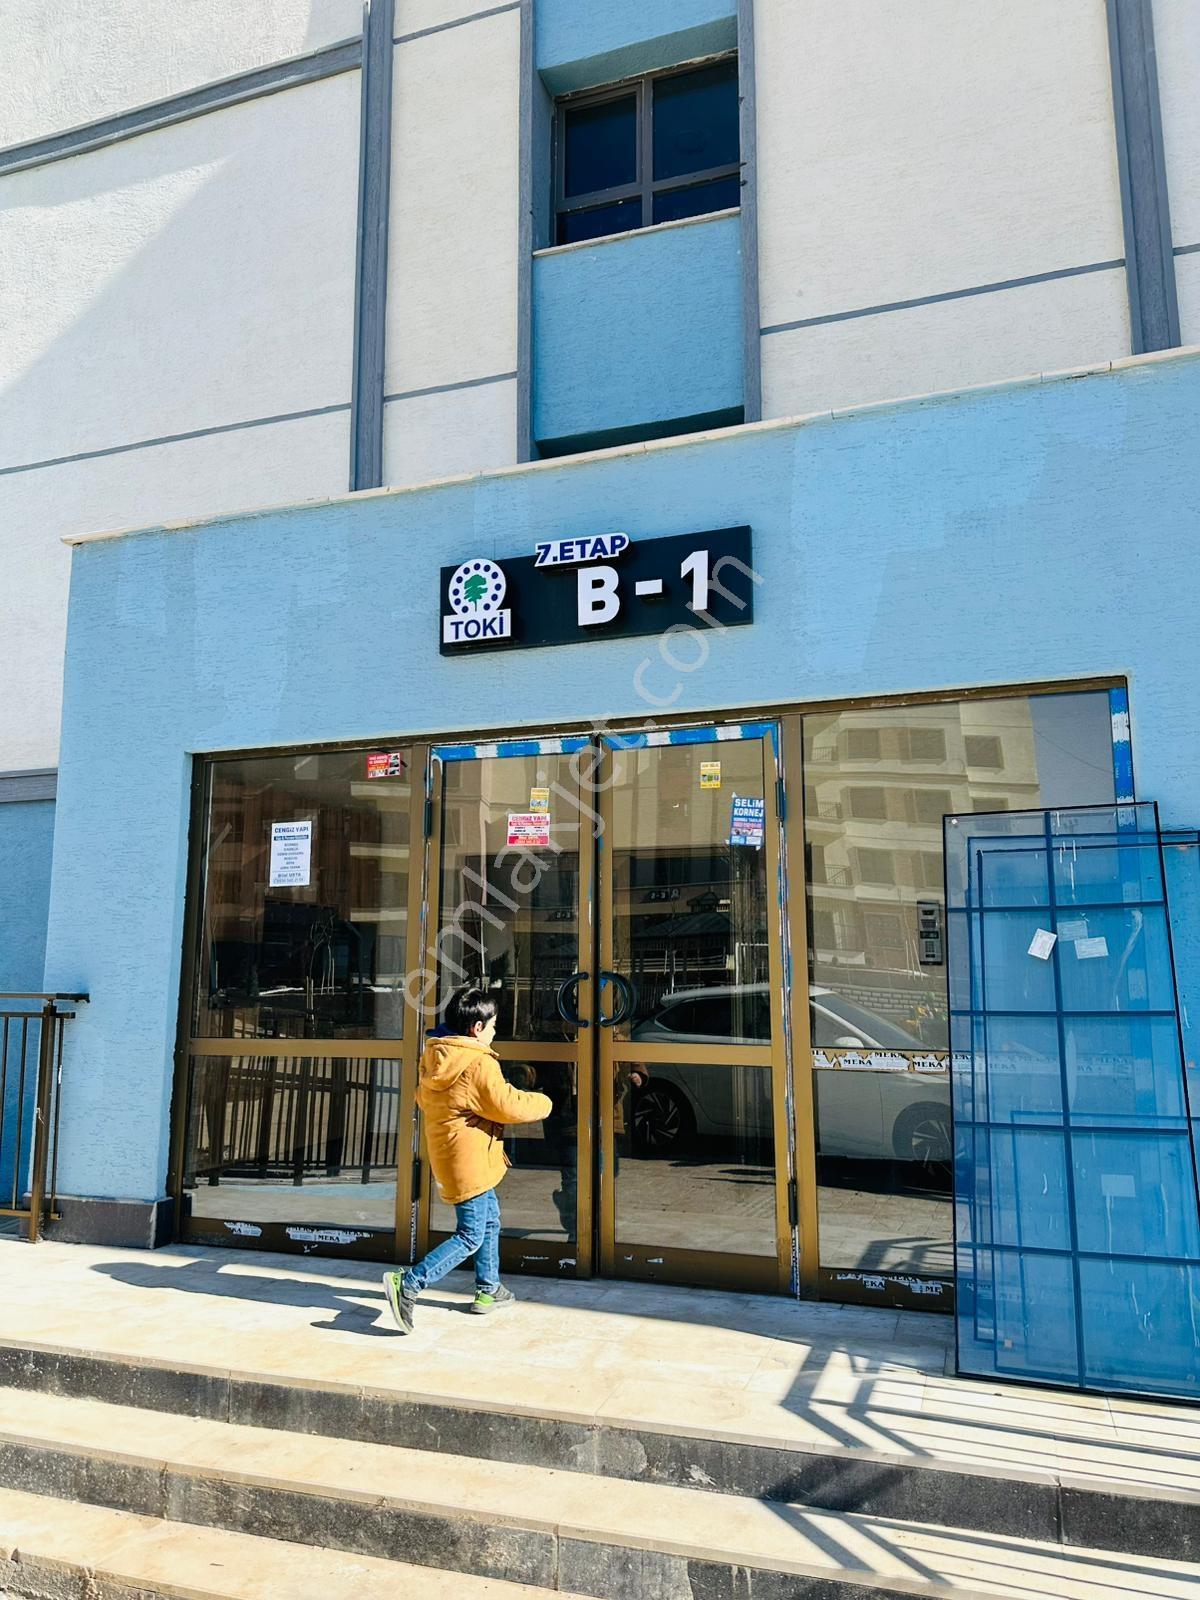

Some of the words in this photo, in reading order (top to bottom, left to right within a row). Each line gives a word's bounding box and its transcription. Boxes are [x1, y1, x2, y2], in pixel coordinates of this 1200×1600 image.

[537, 535, 627, 564] 7.ETAP
[449, 612, 505, 640] TOKİ
[843, 1058, 873, 1067] MEKA
[913, 1060, 944, 1069] MEKA
